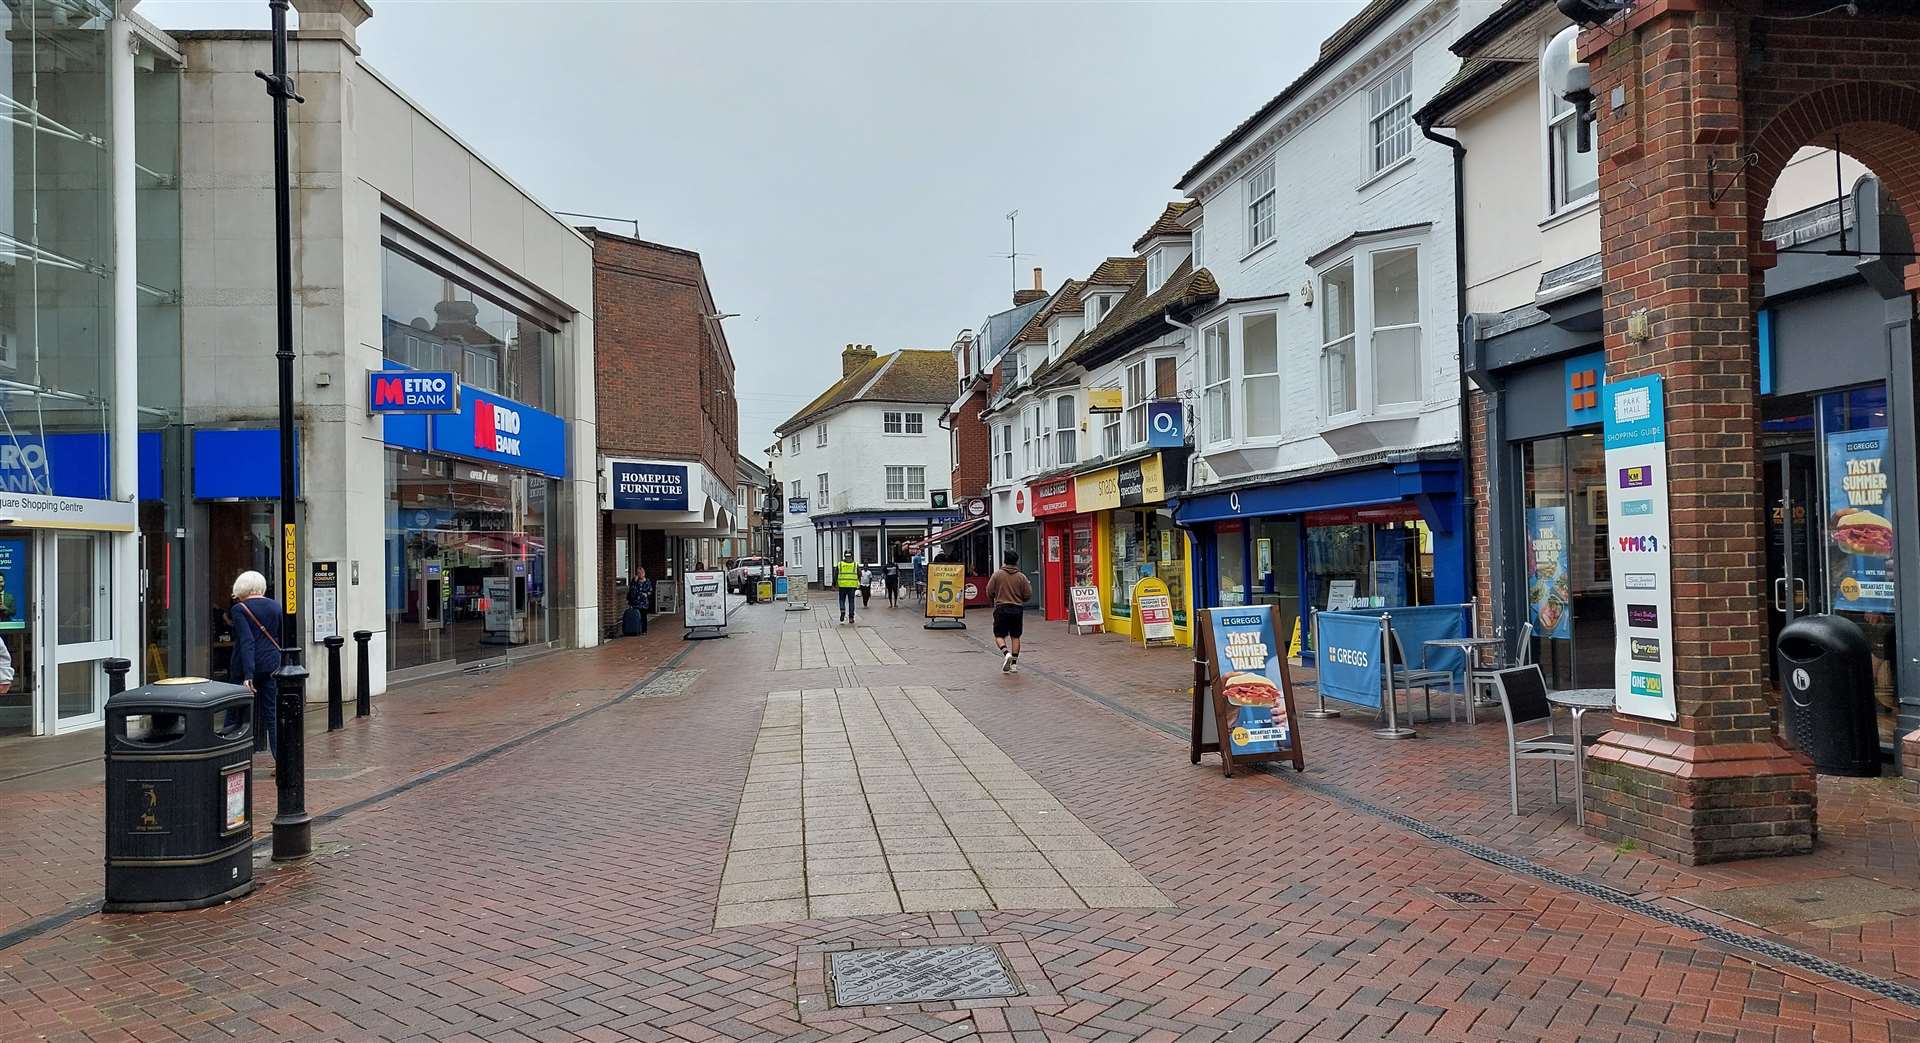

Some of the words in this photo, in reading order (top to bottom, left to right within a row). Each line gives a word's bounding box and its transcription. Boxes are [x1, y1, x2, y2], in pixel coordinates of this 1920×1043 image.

[375, 378, 446, 405] METRO
[406, 394, 446, 405] BANK
[1623, 397, 1640, 406] PARK
[1623, 406, 1641, 414] MALL
[474, 399, 521, 451] METRO
[1607, 430, 1639, 442] SHOPPING
[1640, 425, 1661, 437] GUIDE
[495, 434, 521, 456] BANK
[1853, 441, 1879, 450] GREGGS
[1846, 458, 1881, 475] TASTY
[482, 469, 488, 480] 7
[621, 472, 681, 485] HOMEPLUS
[1842, 473, 1887, 491] SUMMER
[619, 483, 683, 495] FURNITURE
[1098, 478, 1116, 500] snaps
[21, 497, 58, 513] Shopping
[60, 501, 84, 513] Centre
[1847, 489, 1883, 506] VALUE
[1539, 528, 1553, 539] THIS
[937, 580, 954, 604] 5
[1346, 595, 1369, 608] Roam
[1230, 616, 1261, 625] GREGGS
[1226, 631, 1261, 645] TASTY
[1225, 643, 1268, 658] SUMMER
[1337, 647, 1368, 668] GREGGS
[1231, 656, 1266, 670] VALUE
[1631, 675, 1646, 689] ONE
[1645, 677, 1661, 690] YOU
